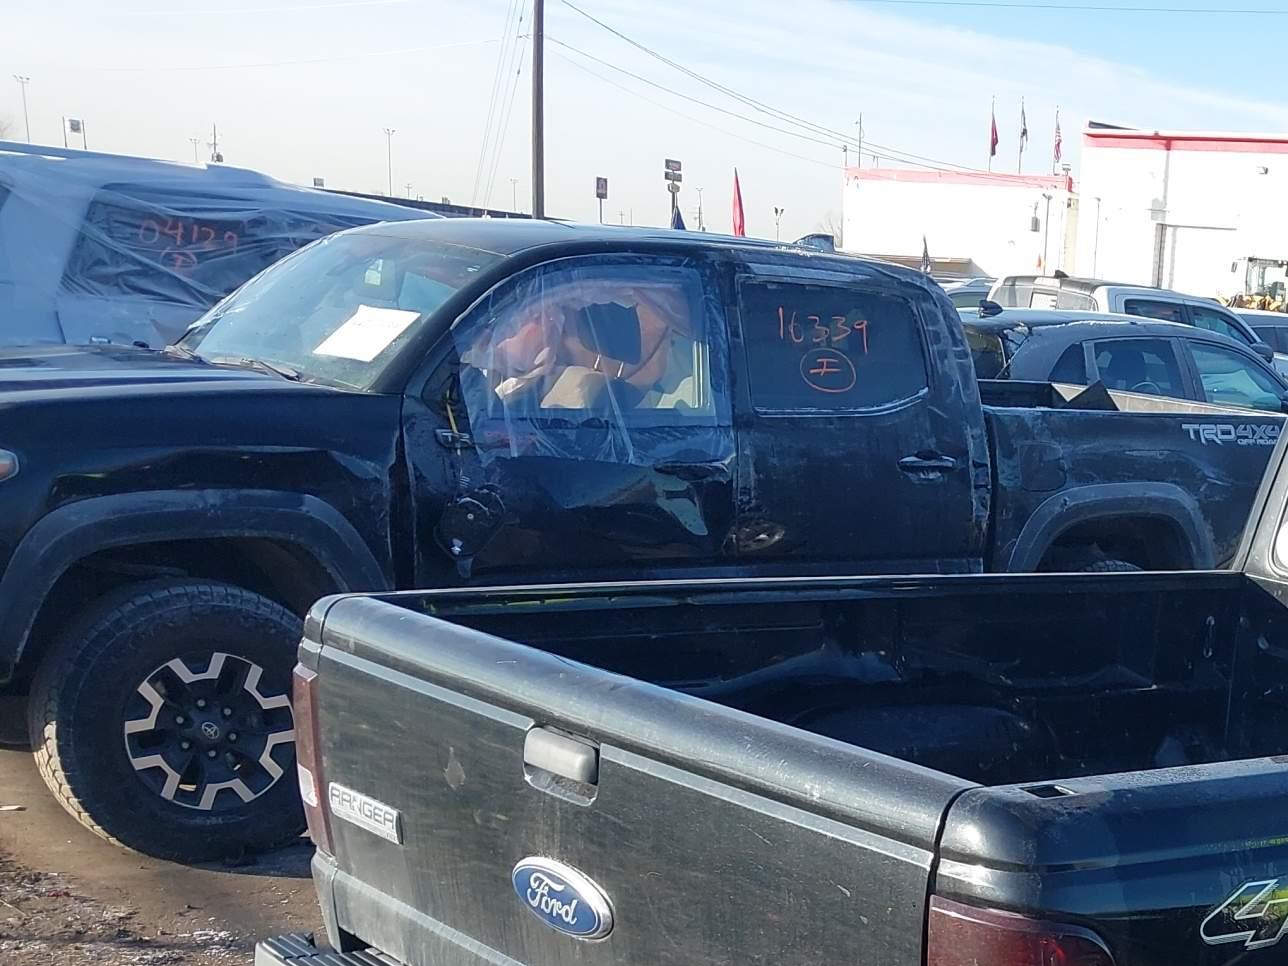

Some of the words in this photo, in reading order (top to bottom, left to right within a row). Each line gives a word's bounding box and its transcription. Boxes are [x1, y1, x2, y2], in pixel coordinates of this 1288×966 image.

[777, 305, 869, 354] 16339
[1181, 423, 1237, 446] TRD
[1256, 438, 1278, 446] ROA
[330, 785, 396, 830] RANGER
[526, 872, 579, 925] Ford
